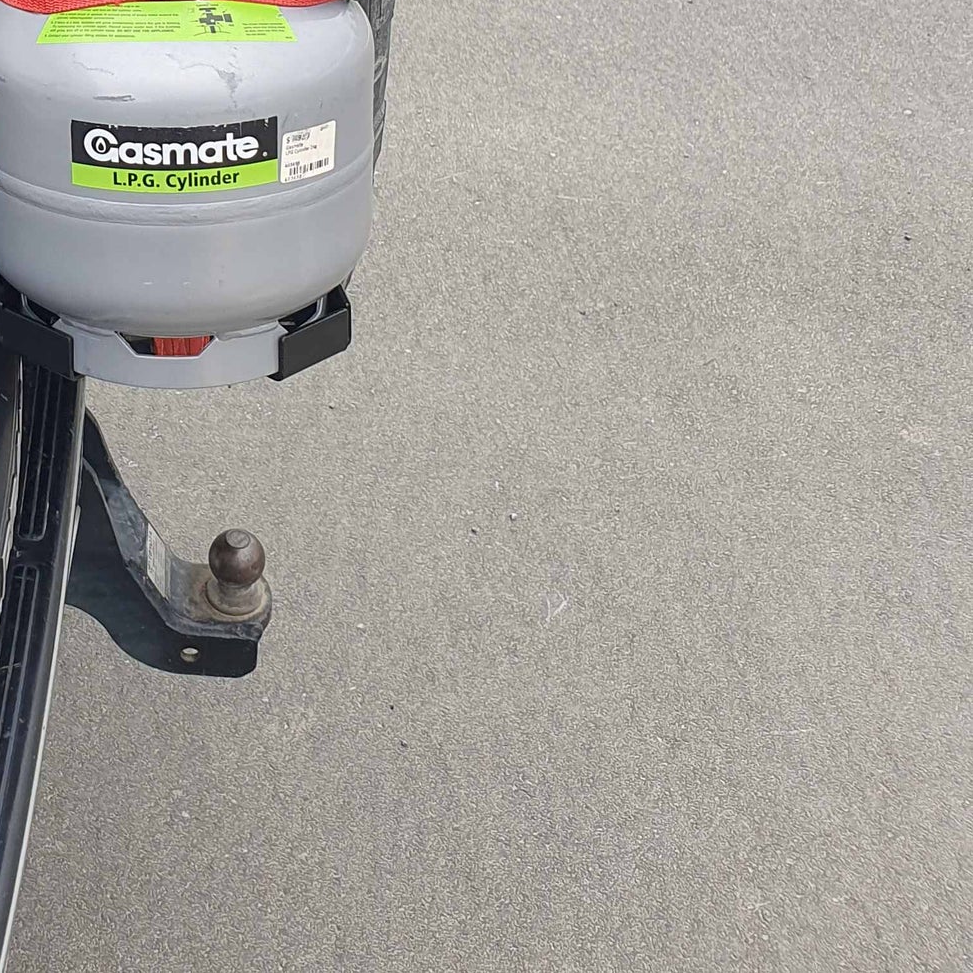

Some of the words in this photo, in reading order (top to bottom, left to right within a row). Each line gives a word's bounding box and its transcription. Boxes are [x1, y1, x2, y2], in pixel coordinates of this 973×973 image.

[83, 127, 259, 166] Gasmate
[113, 171, 160, 188] L.P.G.
[165, 170, 240, 191] Cylinder
